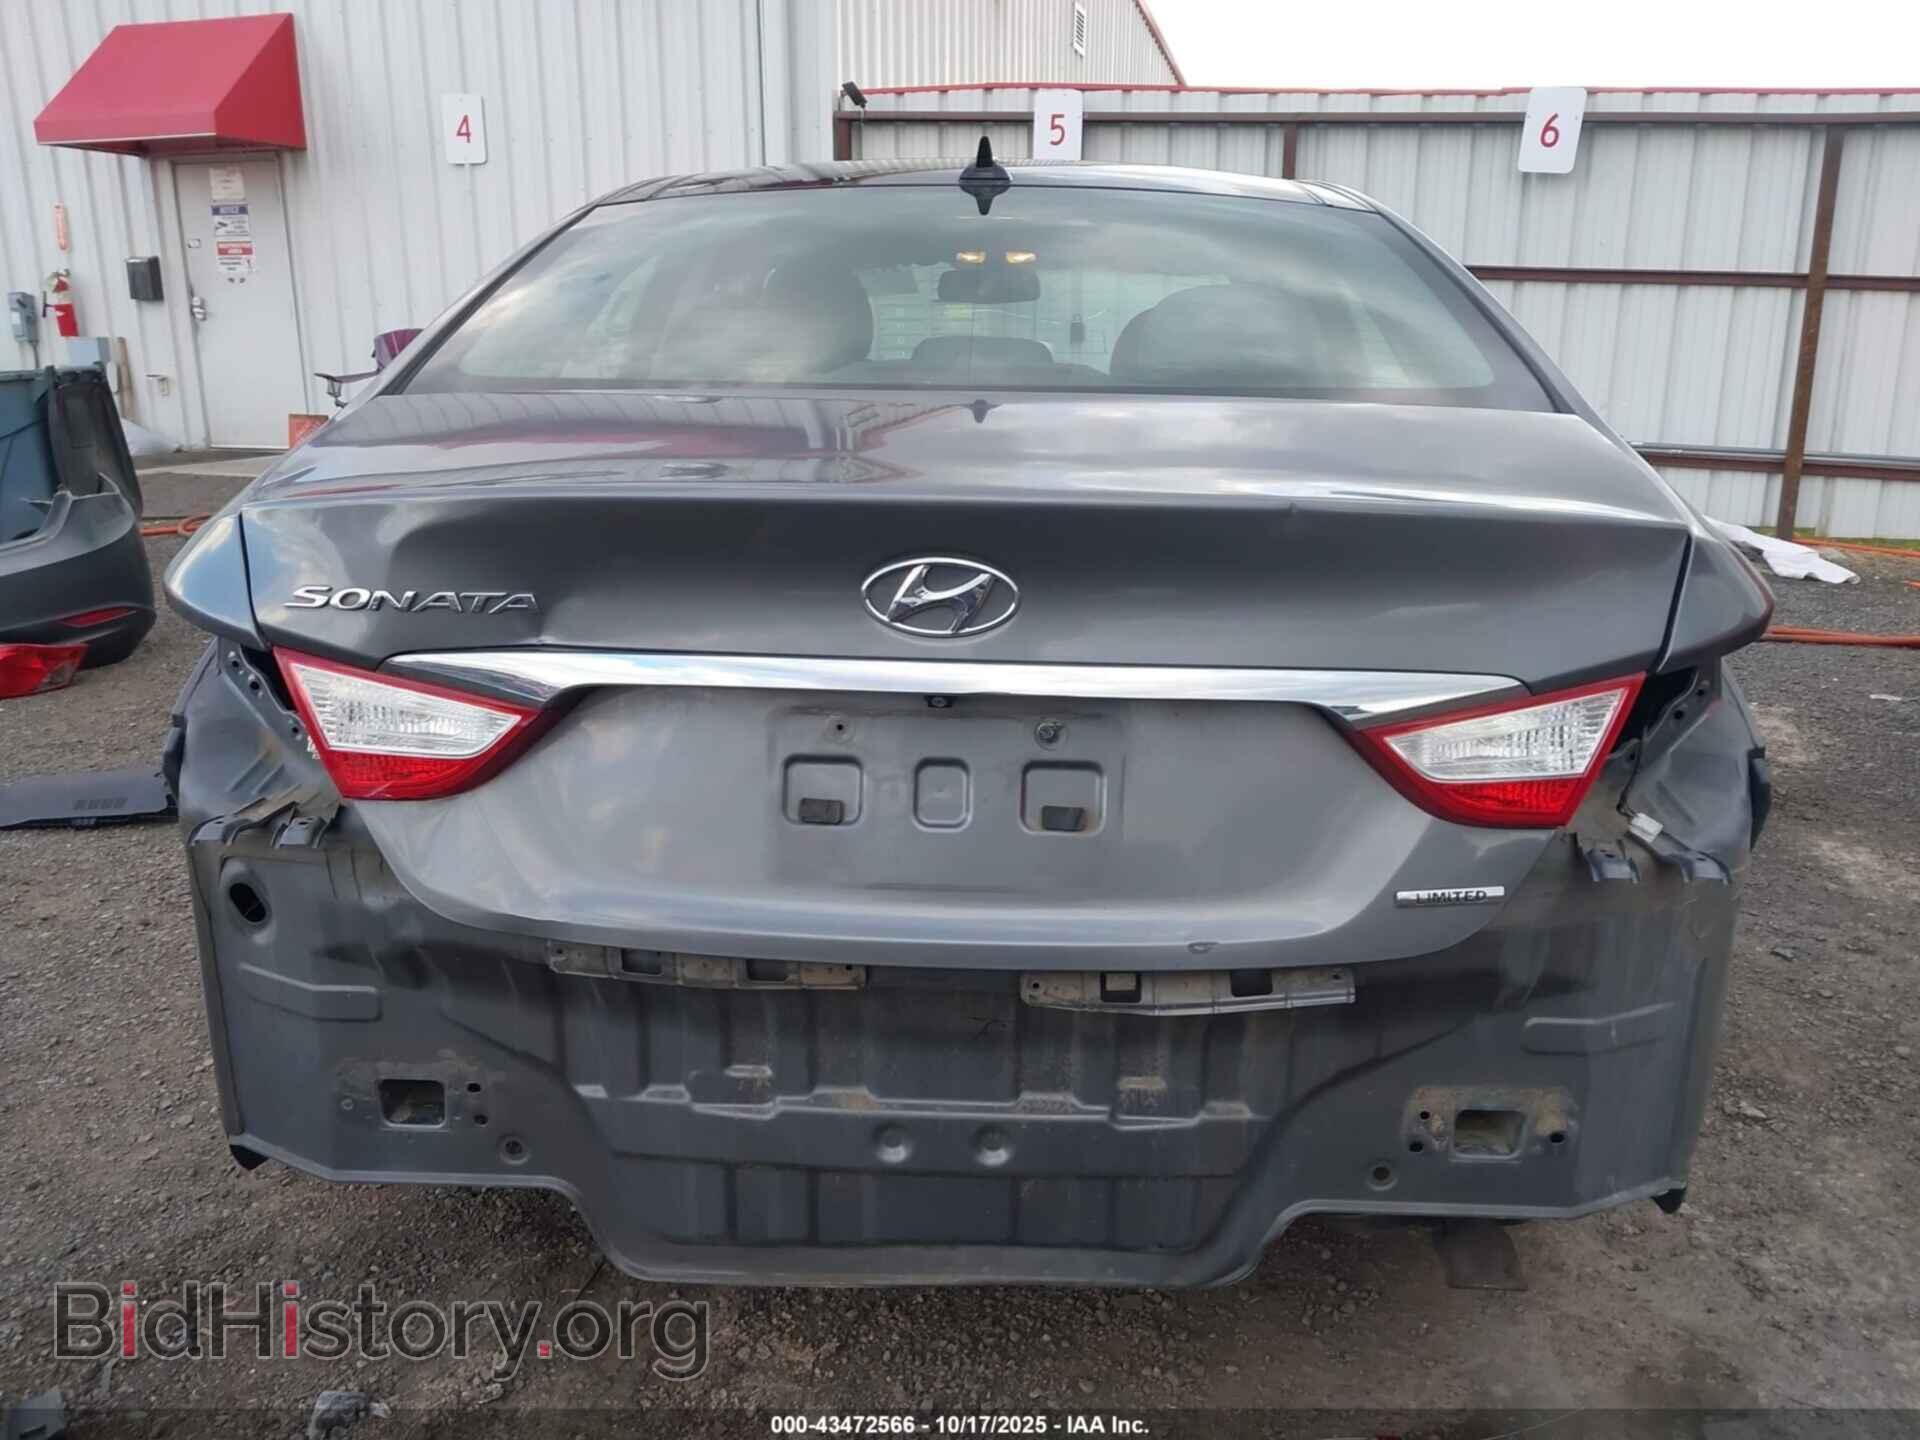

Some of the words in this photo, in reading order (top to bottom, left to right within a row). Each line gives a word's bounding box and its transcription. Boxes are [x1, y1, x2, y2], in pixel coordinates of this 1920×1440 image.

[456, 114, 472, 143] 4
[1049, 113, 1066, 146] 5
[1540, 113, 1559, 148] 6
[283, 585, 539, 615] SONATA
[1415, 890, 1488, 905] LIMITED
